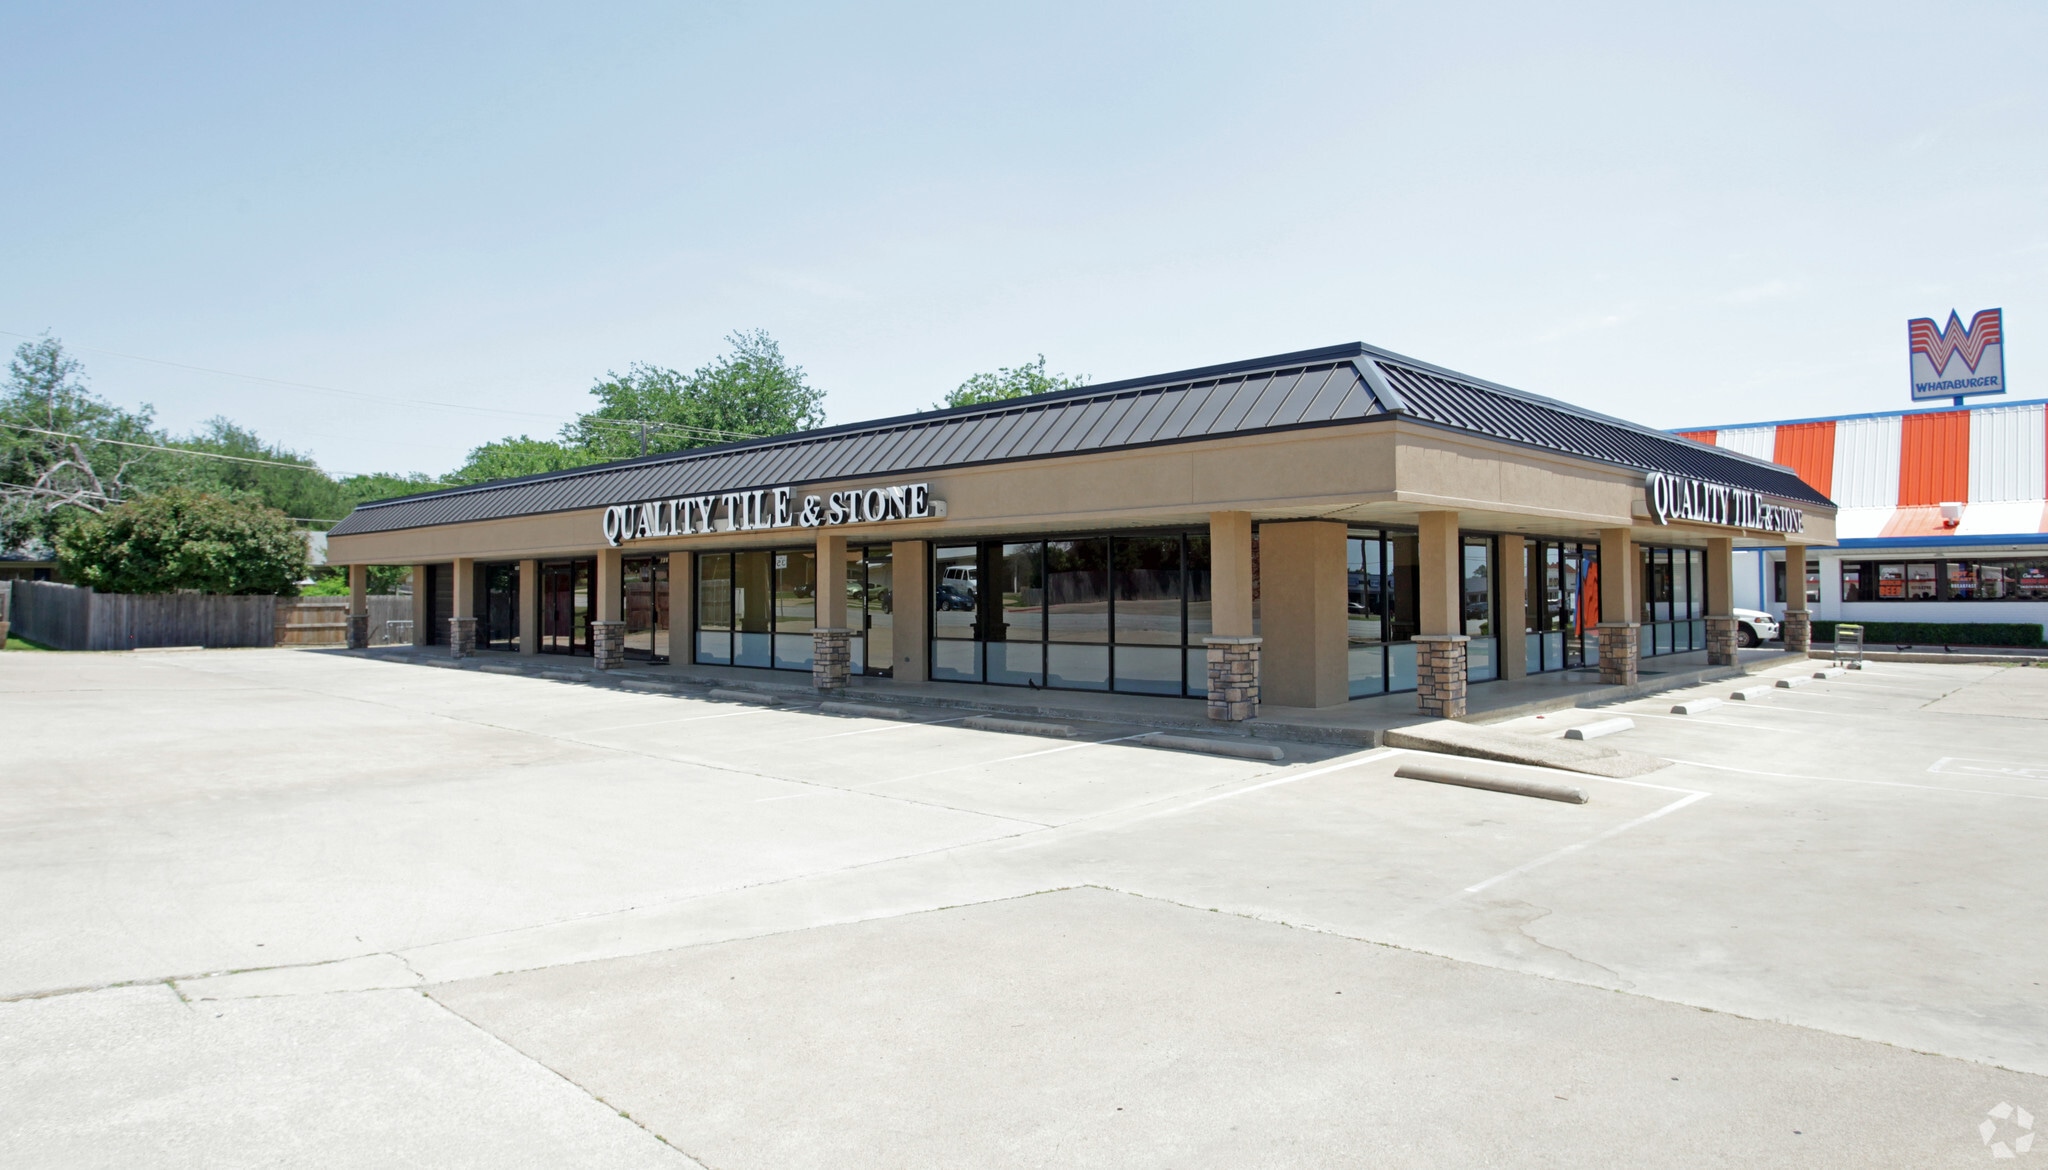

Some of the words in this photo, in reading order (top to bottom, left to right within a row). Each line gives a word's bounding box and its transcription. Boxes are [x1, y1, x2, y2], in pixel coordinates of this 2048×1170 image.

[1916, 376, 1998, 392] WHATABURGER
[602, 497, 716, 546] QUALITY
[722, 487, 794, 531] TILE
[799, 495, 825, 527] &
[829, 483, 929, 525] STONE
[1653, 472, 1729, 526] QUALITY
[1733, 488, 1763, 529] TILE
[1774, 507, 1803, 533] STONE
